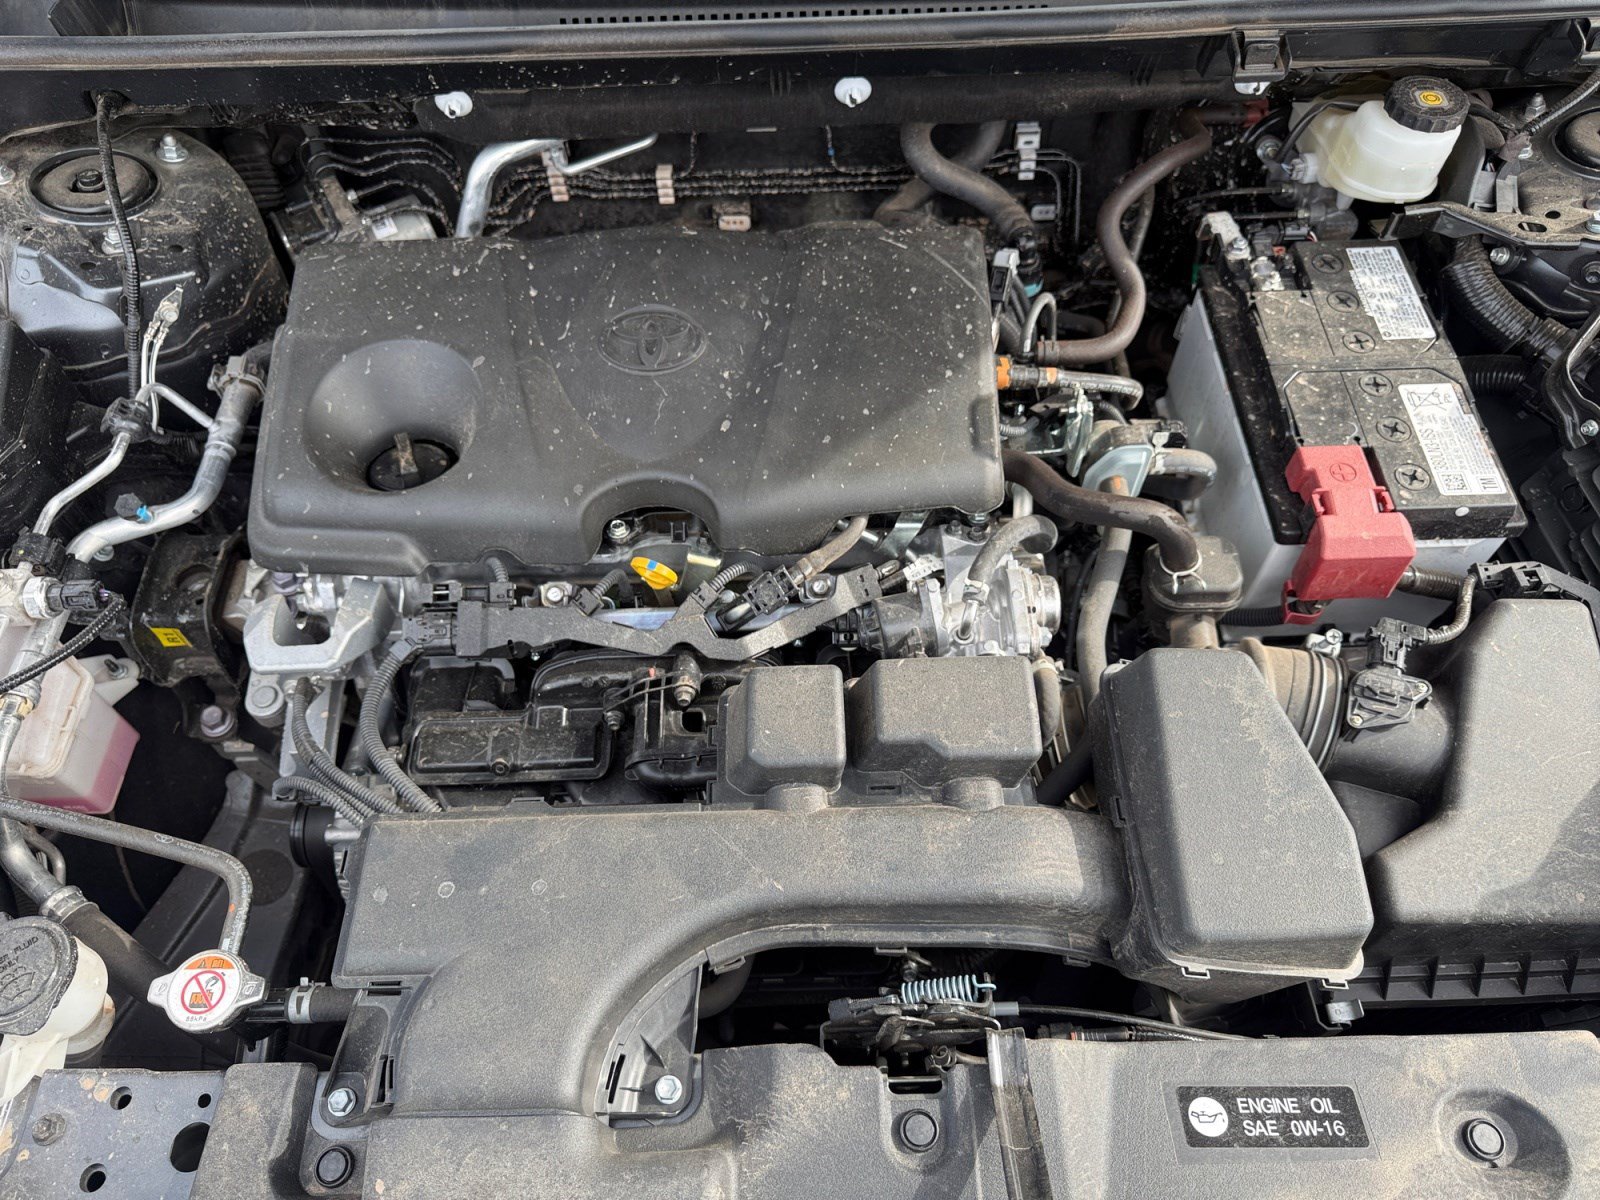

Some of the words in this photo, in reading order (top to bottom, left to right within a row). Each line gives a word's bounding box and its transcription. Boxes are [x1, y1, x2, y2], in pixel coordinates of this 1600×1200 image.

[13, 936, 39, 954] FLUID
[1236, 1097, 1301, 1114] ENGINE
[1310, 1097, 1341, 1114] OIL
[1243, 1120, 1280, 1137] SAE
[1290, 1120, 1346, 1137] 0W-16
